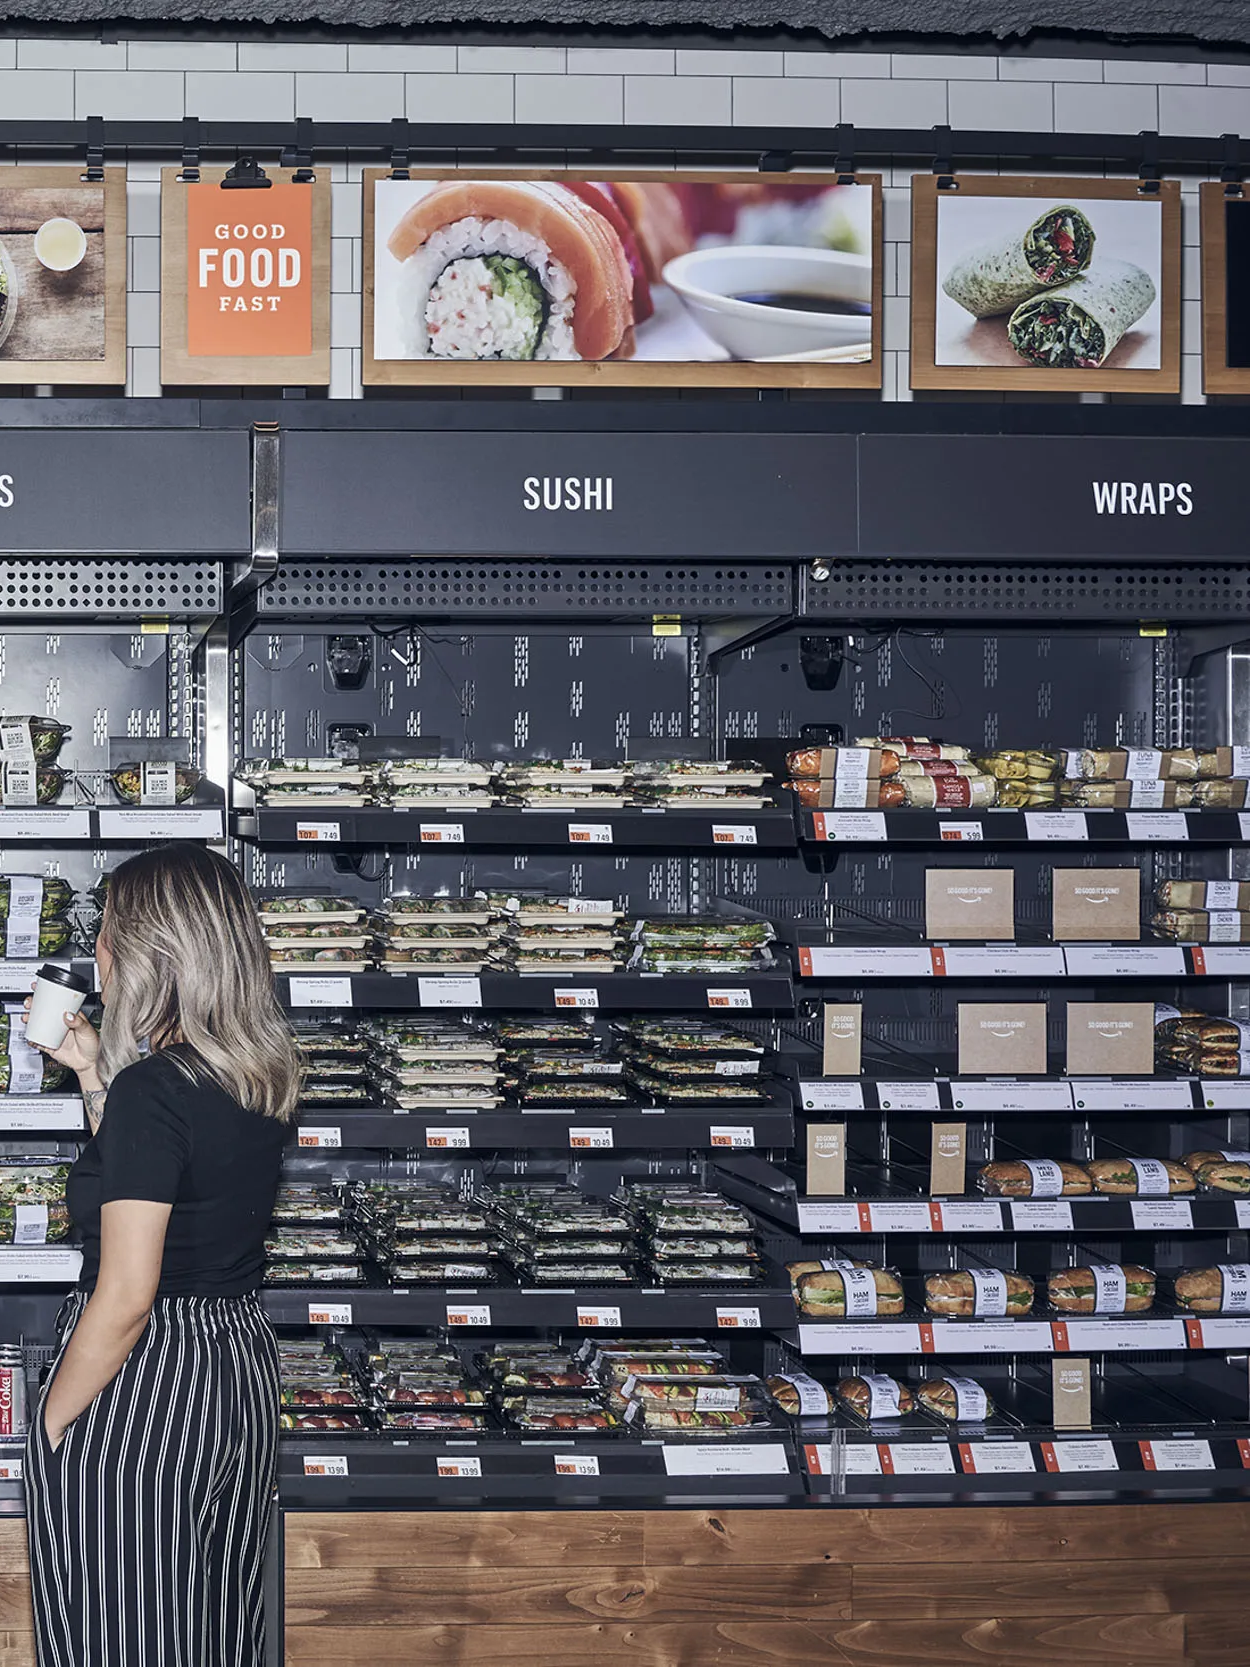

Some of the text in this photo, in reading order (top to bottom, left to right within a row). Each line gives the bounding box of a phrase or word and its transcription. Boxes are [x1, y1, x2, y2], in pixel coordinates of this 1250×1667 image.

[214, 223, 285, 240] GOOD
[199, 247, 301, 288] FOOD
[219, 296, 281, 312] FAST
[523, 476, 613, 511] SUSHI
[1092, 481, 1193, 515] WRAPS
[0, 1377, 11, 1409] Coke
